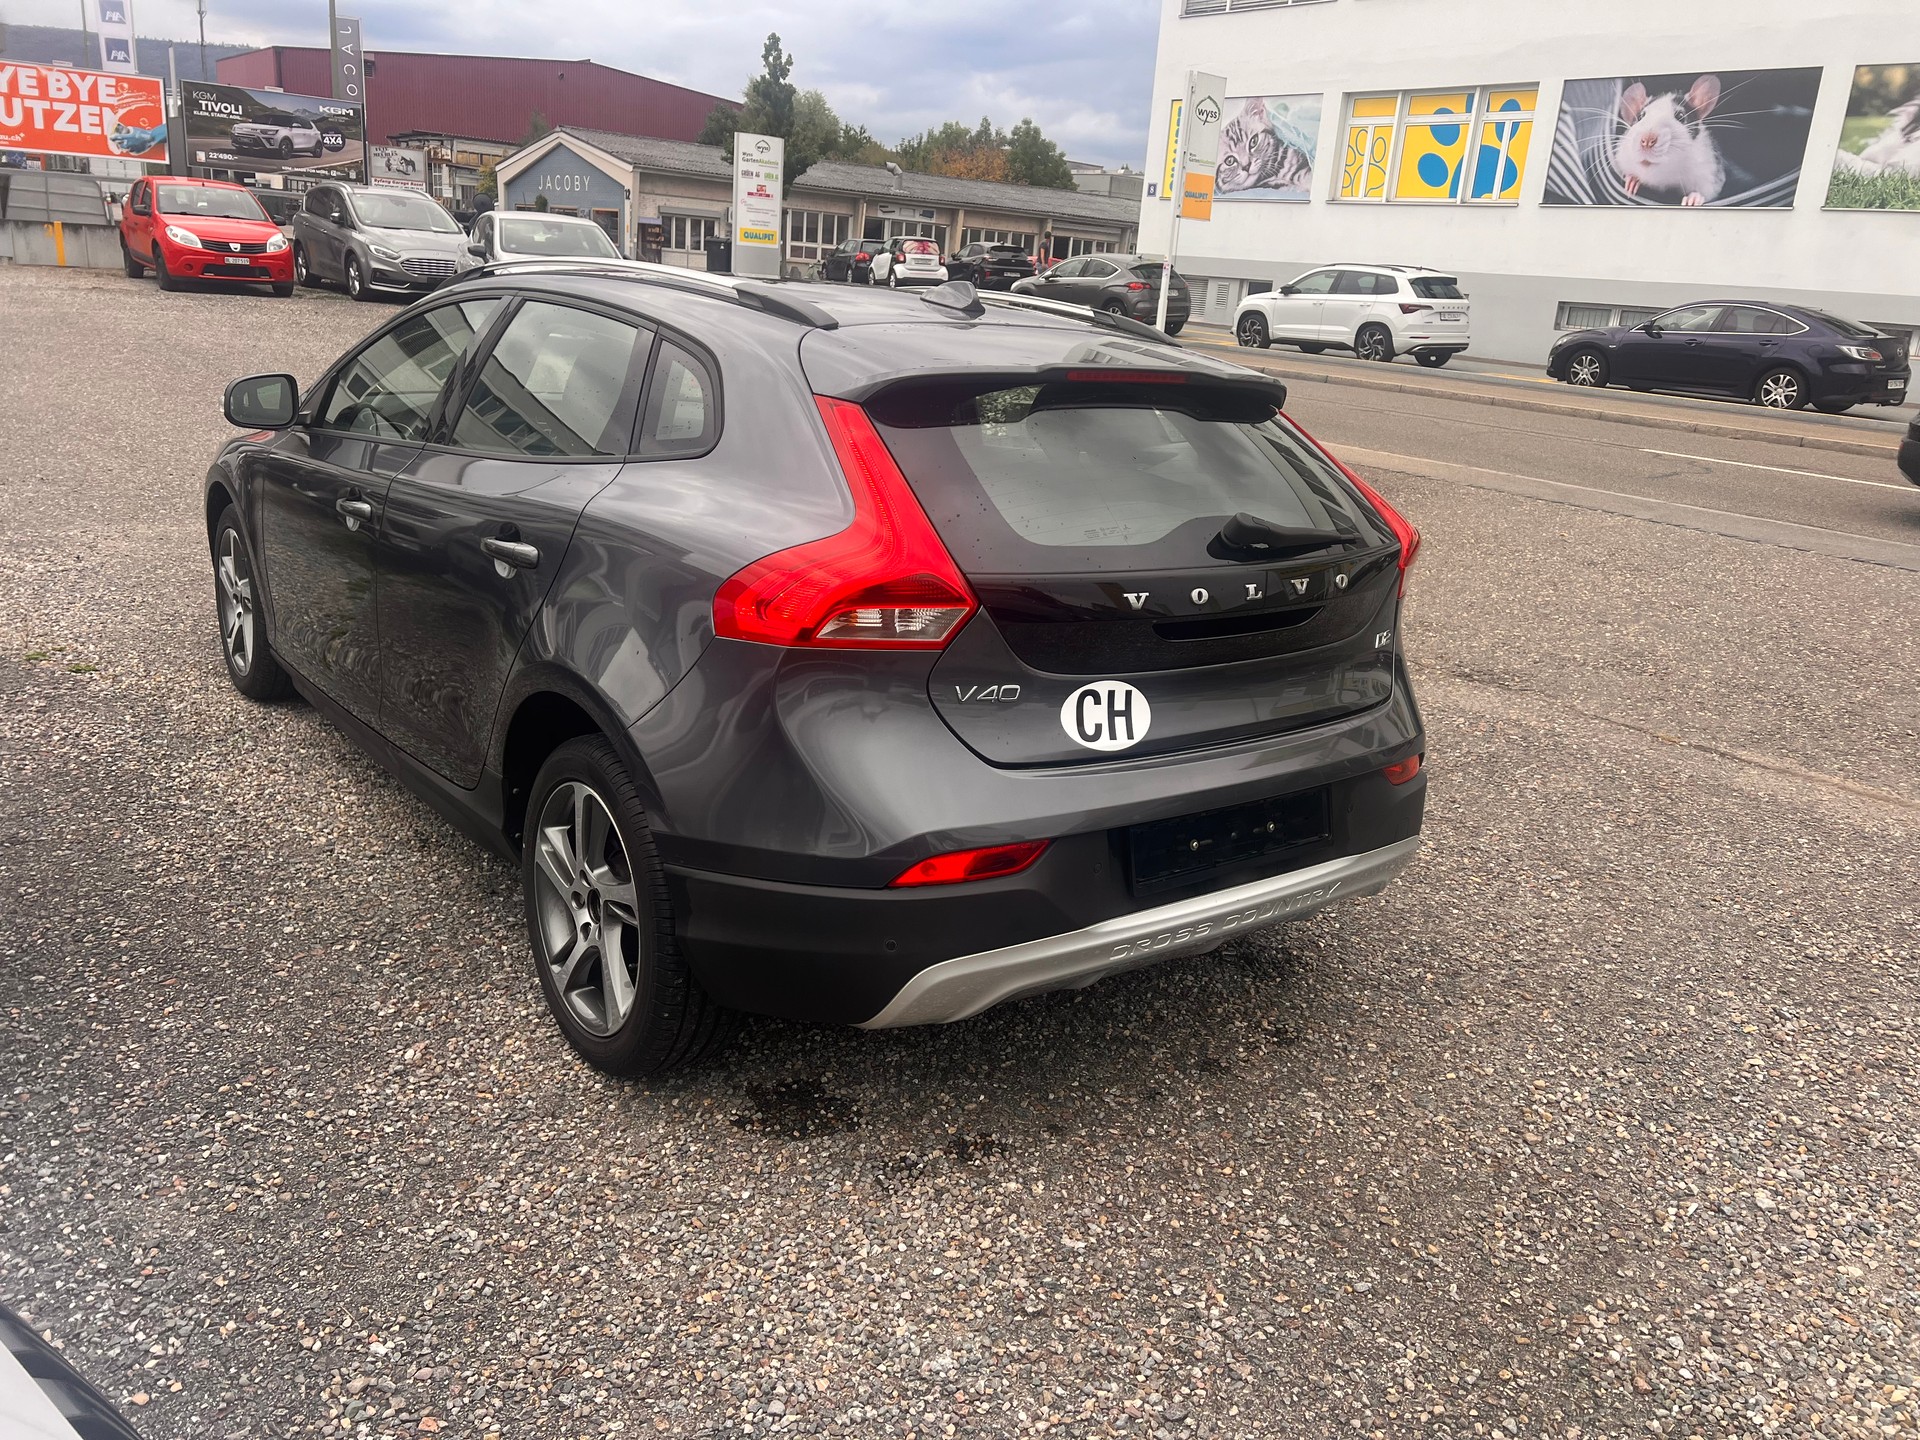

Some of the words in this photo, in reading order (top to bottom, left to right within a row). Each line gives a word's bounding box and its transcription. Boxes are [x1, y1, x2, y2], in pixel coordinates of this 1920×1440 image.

[105, 10, 126, 22] AXA
[110, 50, 131, 61] AXA
[47, 71, 118, 105] BYE
[192, 91, 217, 101] KGM
[198, 100, 243, 115] TIVOLI
[318, 105, 354, 117] KGM
[1197, 108, 1218, 125] wyss
[323, 136, 343, 145] 4X4
[538, 175, 590, 191] JACOBY
[1149, 185, 1155, 194] 8
[624, 189, 631, 200] 12
[743, 231, 775, 240] QUALIPET
[1123, 573, 1350, 611] VOLVO
[954, 684, 1021, 703] V40
[1075, 688, 1135, 743] CH
[1109, 921, 1214, 961] CROSS
[1221, 881, 1342, 930] COUNTRY
